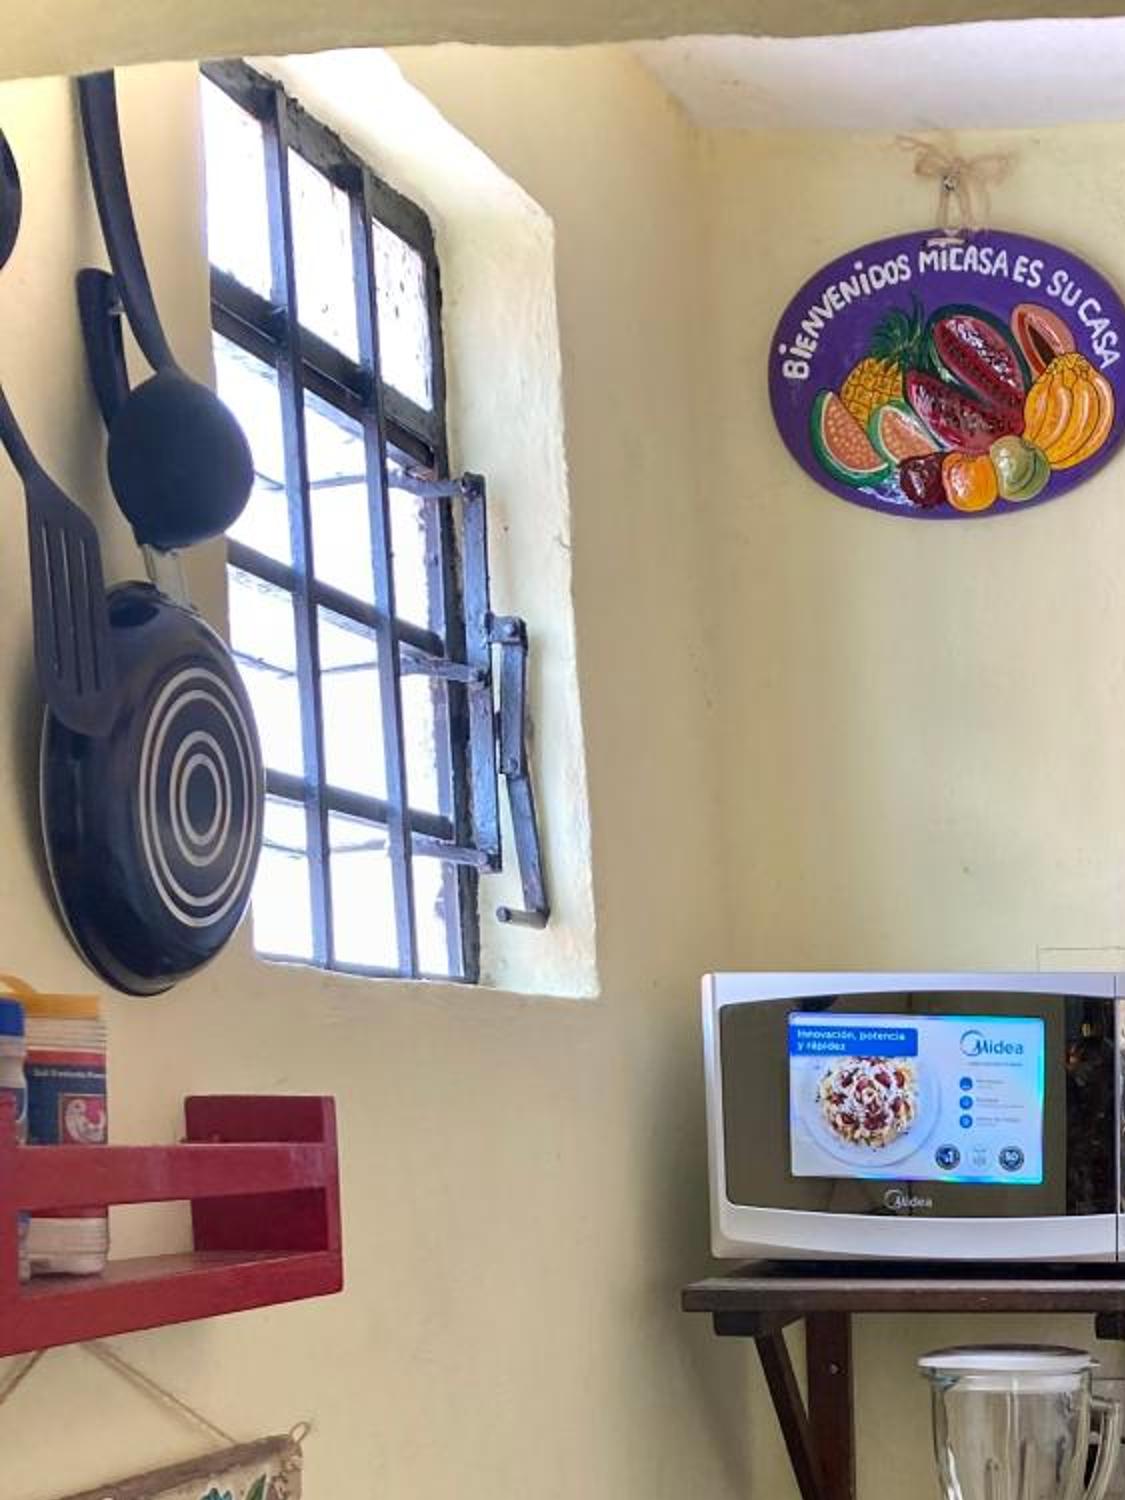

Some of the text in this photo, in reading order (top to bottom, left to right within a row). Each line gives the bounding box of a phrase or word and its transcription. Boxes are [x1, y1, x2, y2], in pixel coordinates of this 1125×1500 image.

[1013, 256, 1044, 287] ES
[859, 1031, 906, 1043] potencia
[960, 1029, 1025, 1057] Midea
